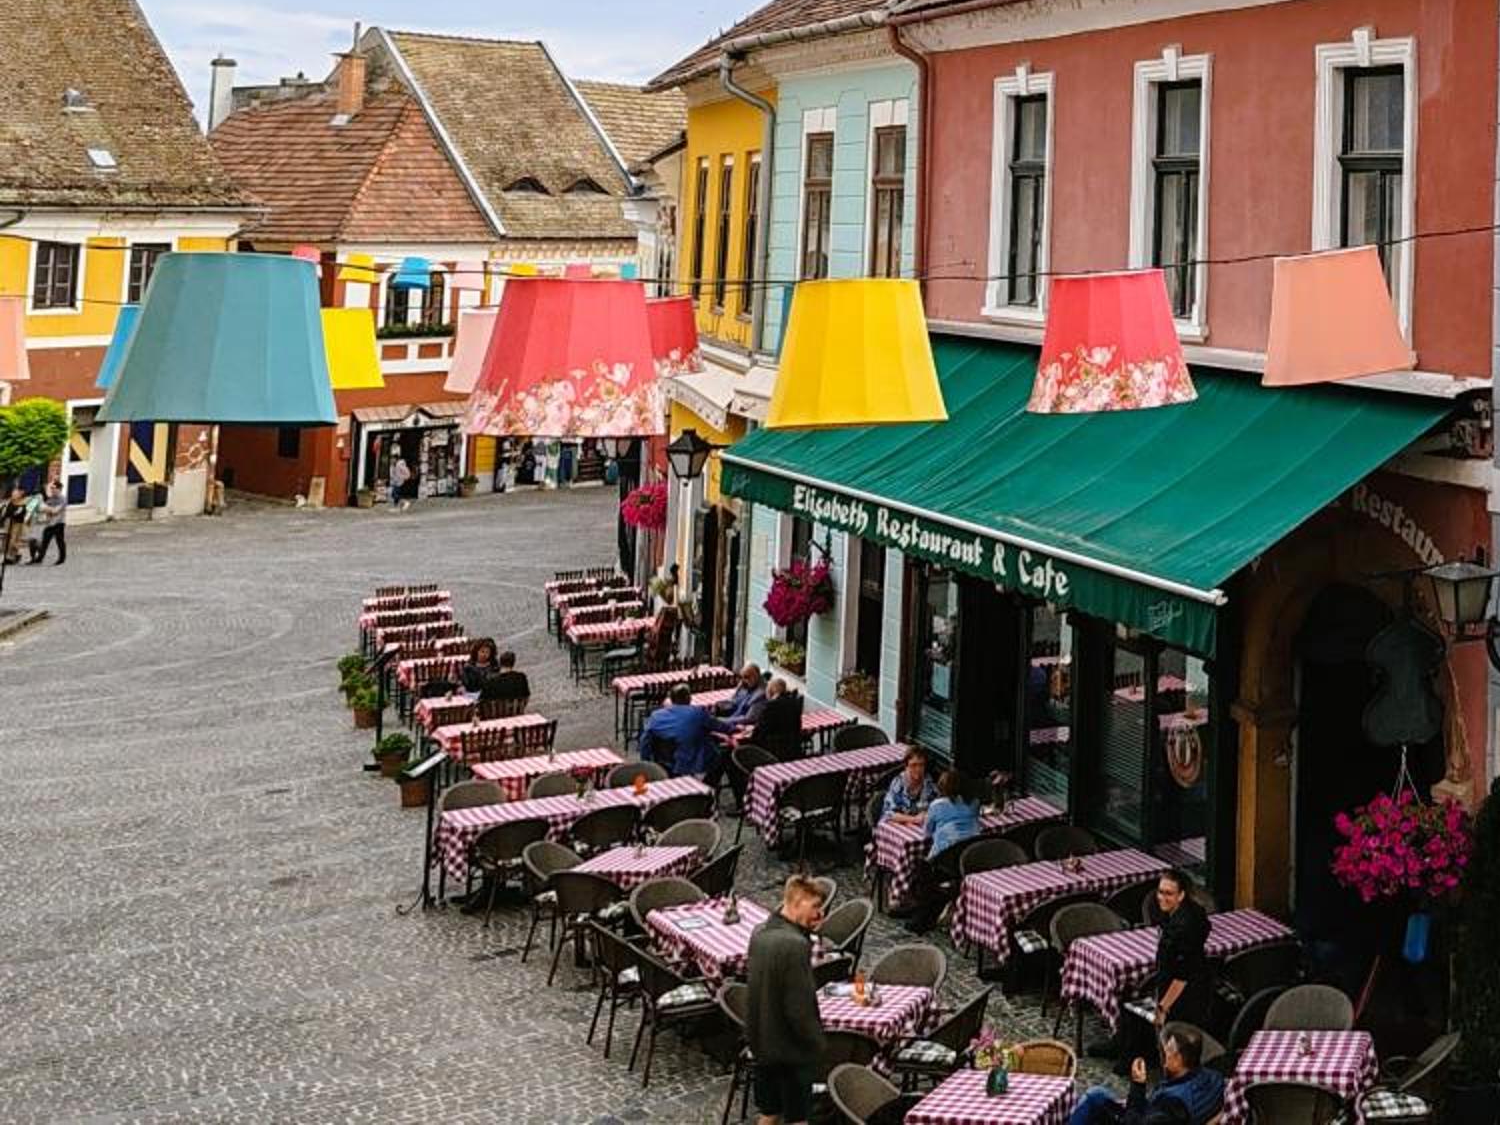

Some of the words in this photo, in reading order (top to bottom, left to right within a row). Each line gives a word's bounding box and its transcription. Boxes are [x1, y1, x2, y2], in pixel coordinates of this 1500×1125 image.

[793, 484, 869, 535] Elisabeth
[876, 507, 984, 567] Restaurant
[992, 542, 1007, 576] &
[1018, 550, 1070, 596] Cafe
